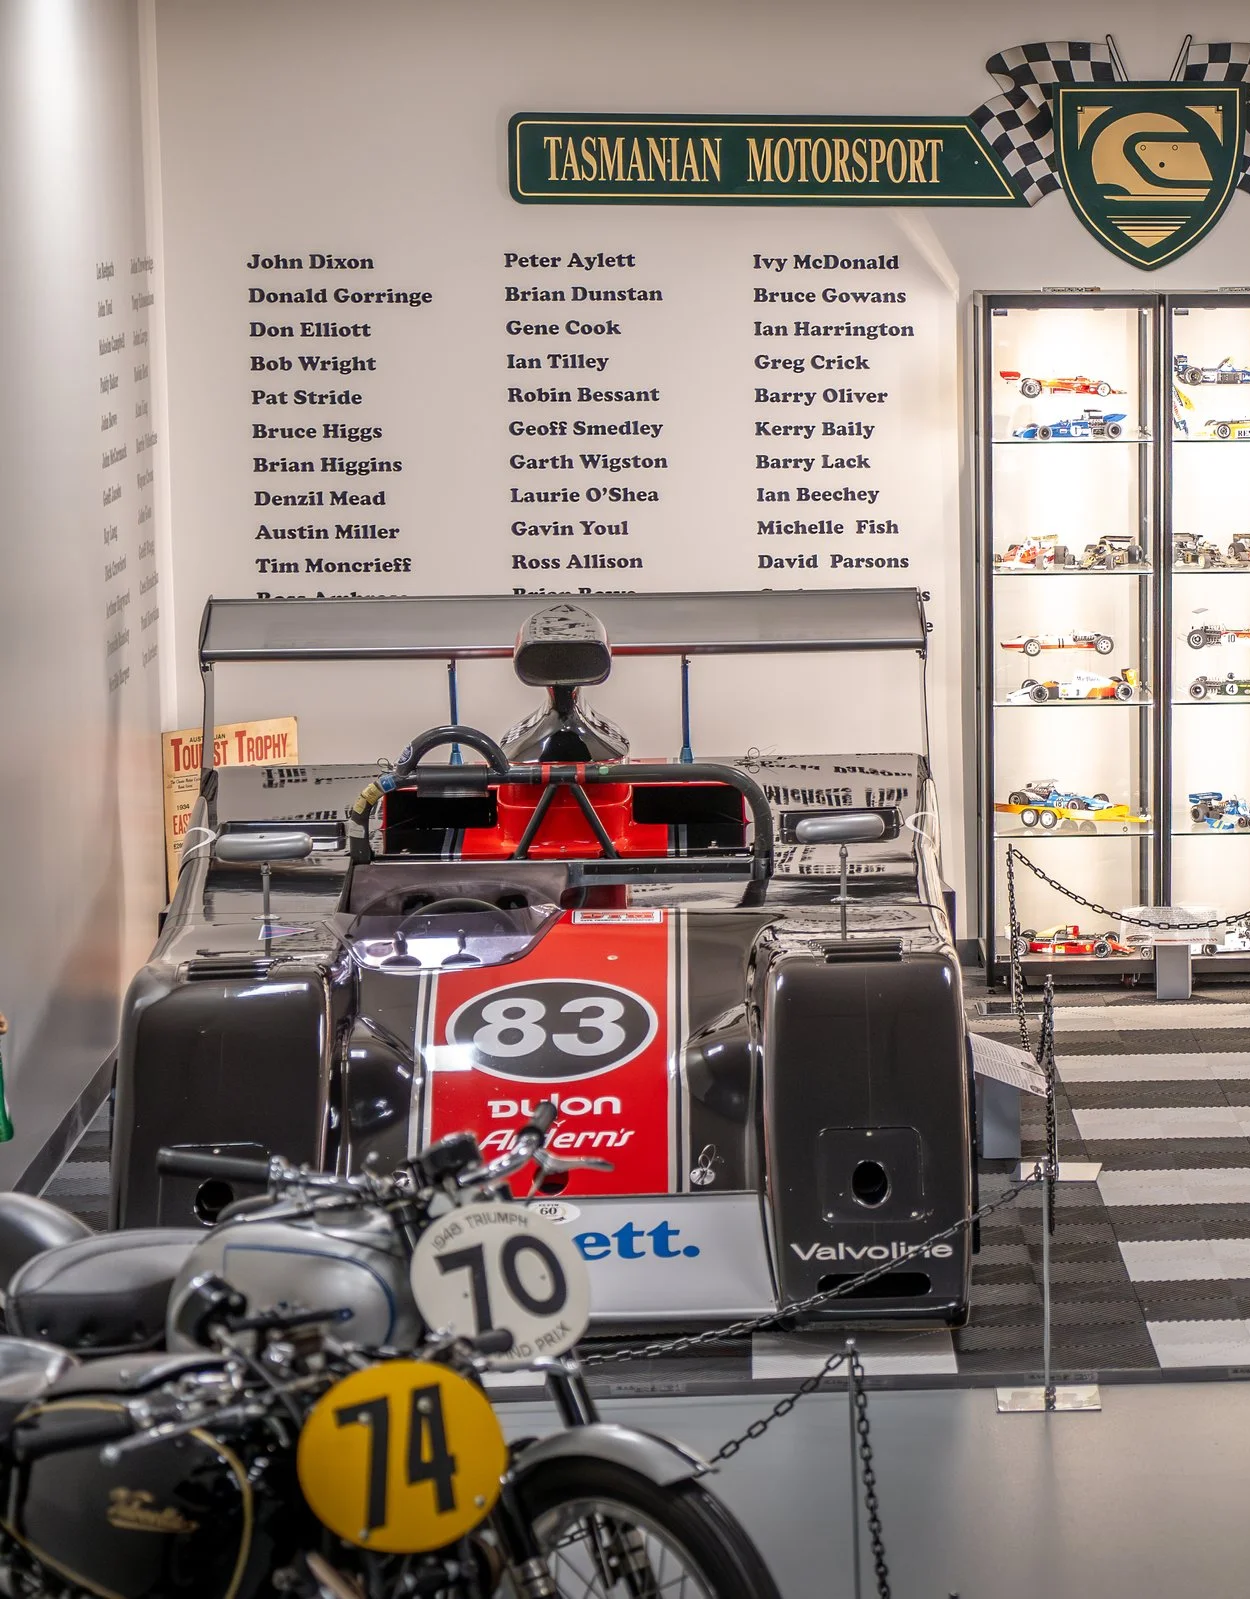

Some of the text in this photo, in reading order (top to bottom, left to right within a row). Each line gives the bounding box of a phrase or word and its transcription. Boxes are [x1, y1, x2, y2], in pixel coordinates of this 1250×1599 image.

[544, 137, 943, 183] TASMANIAN MOTORSPORT
[247, 254, 374, 269] John Dixon
[504, 253, 635, 271] Peter Aylett
[753, 254, 899, 272] Ivy McDonald
[249, 288, 432, 307] Donald Gorringe
[505, 287, 663, 301] Brian Dunstan
[754, 288, 906, 303] Bruce Gowans
[250, 322, 371, 337] Don Elliott
[506, 320, 621, 335] Gene Cook
[754, 322, 914, 340] Ian Harrington
[250, 356, 376, 374] Bob Wright
[507, 354, 609, 371] Ian Tilley
[755, 355, 870, 373] Greg Crick
[251, 390, 362, 404] Pat Stride
[508, 388, 659, 402] Robin Bessant
[755, 388, 888, 406] Barry Oliver
[252, 424, 382, 442] Bruce Higgs
[509, 421, 663, 438] Geoff Smedley
[755, 422, 875, 439] Kerry Baily
[253, 458, 402, 475] Brian Higgins
[510, 454, 668, 472] Garth Wigston
[756, 455, 870, 472] Barry Lack
[254, 491, 386, 506] Denzil Mead
[510, 488, 580, 502] Laurie
[757, 487, 879, 504] Ian Beechey
[255, 525, 399, 539] Austin Miller
[511, 521, 628, 536] Gavin Youl
[757, 520, 898, 535] Michelle Fish
[256, 558, 411, 573] Tim Moncrieff
[512, 554, 643, 569] Ross Allison
[758, 554, 909, 568] David Parsons
[1228, 684, 1235, 694] 4
[171, 730, 288, 772] TOUST TROPHY
[473, 997, 626, 1057] 83
[540, 1207, 557, 1215] 60
[432, 1211, 529, 1251] 1948 TRIUMPH
[790, 1241, 953, 1261] Valvoline
[434, 1233, 567, 1334] 70
[534, 1320, 571, 1351] PRIX
[334, 1381, 457, 1530] 74
